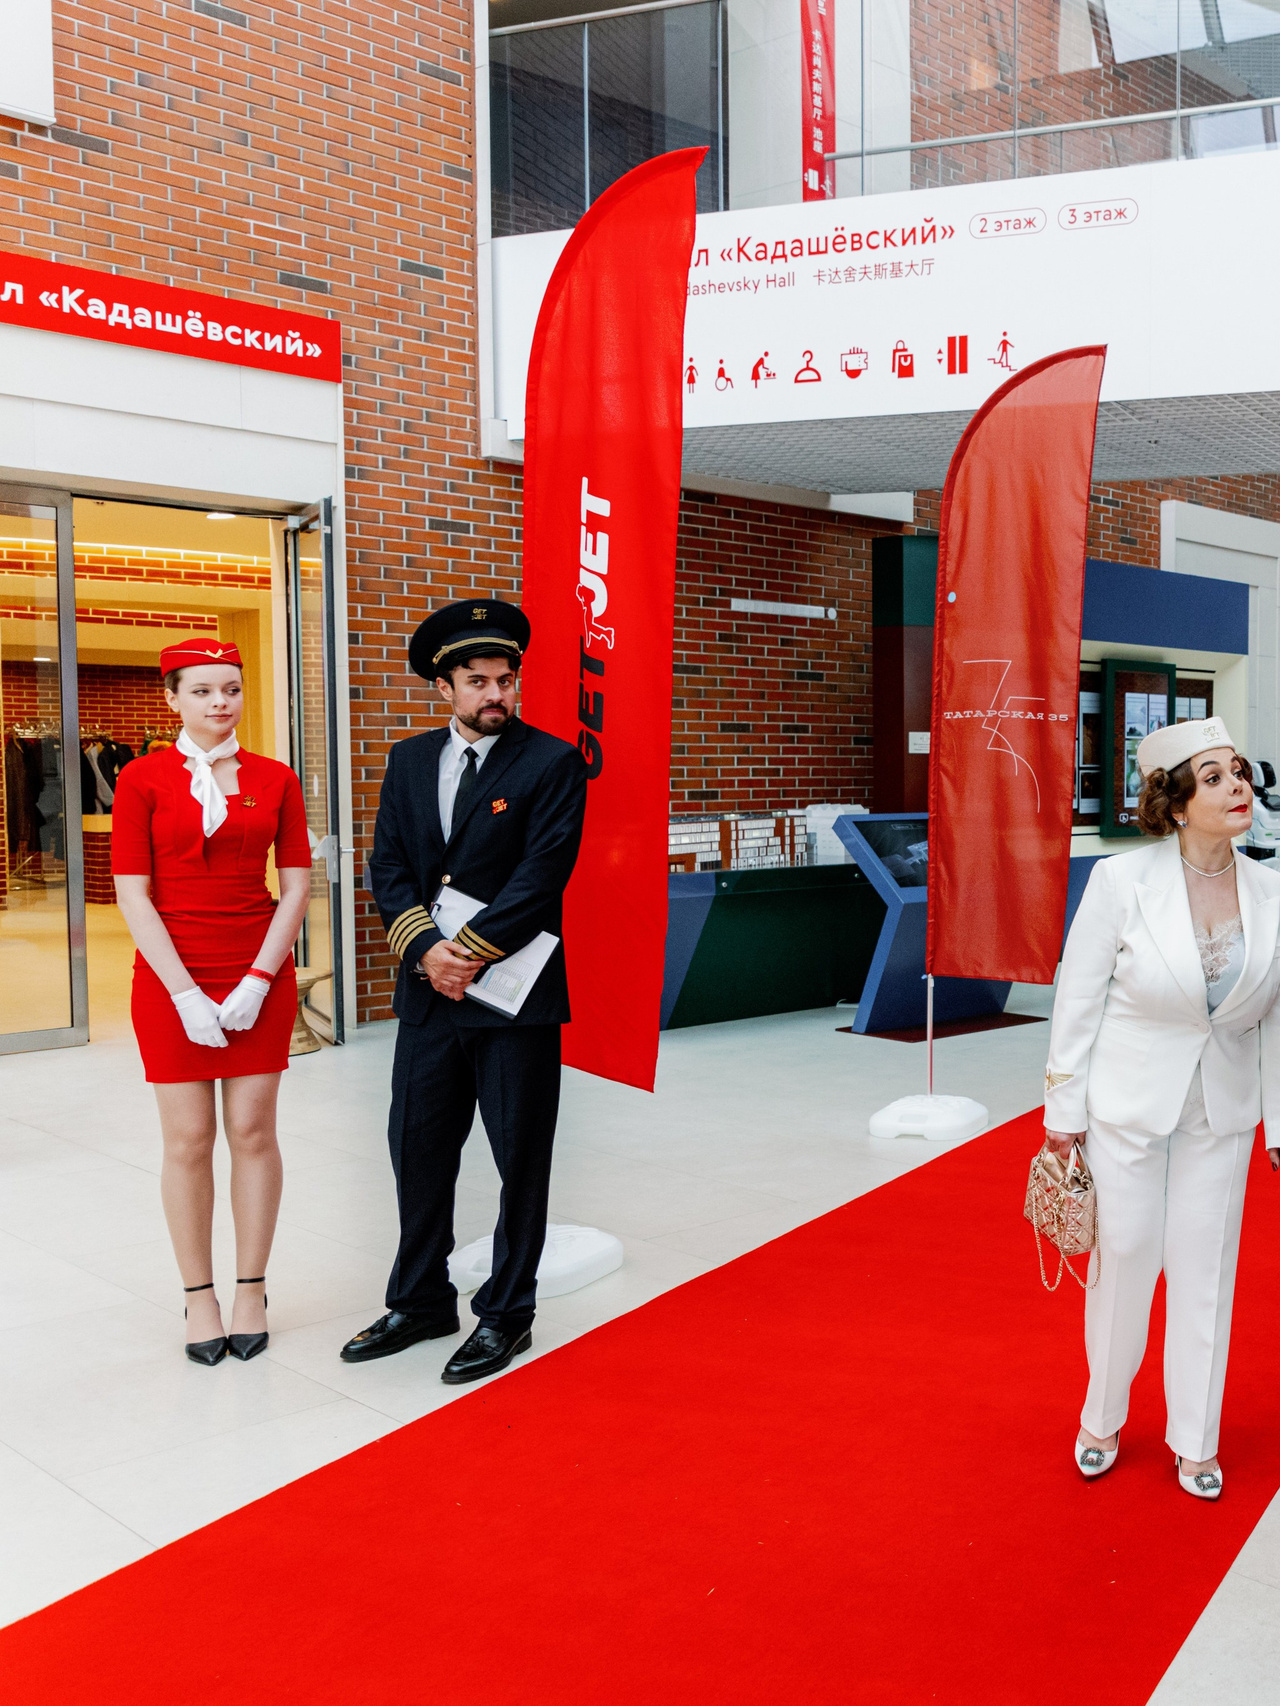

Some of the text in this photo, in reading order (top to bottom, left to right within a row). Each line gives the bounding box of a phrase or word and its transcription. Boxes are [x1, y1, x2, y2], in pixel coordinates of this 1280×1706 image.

[1068, 207, 1128, 224] 3 этаж
[979, 216, 1037, 233] 2 этаж
[690, 217, 955, 268] л «Кадашёвский»
[766, 272, 796, 289] Hall
[39, 285, 323, 358] «Кадашёвский»
[576, 476, 611, 780] GET JET
[943, 709, 1070, 722] ТАТАРСКАЯ 35
